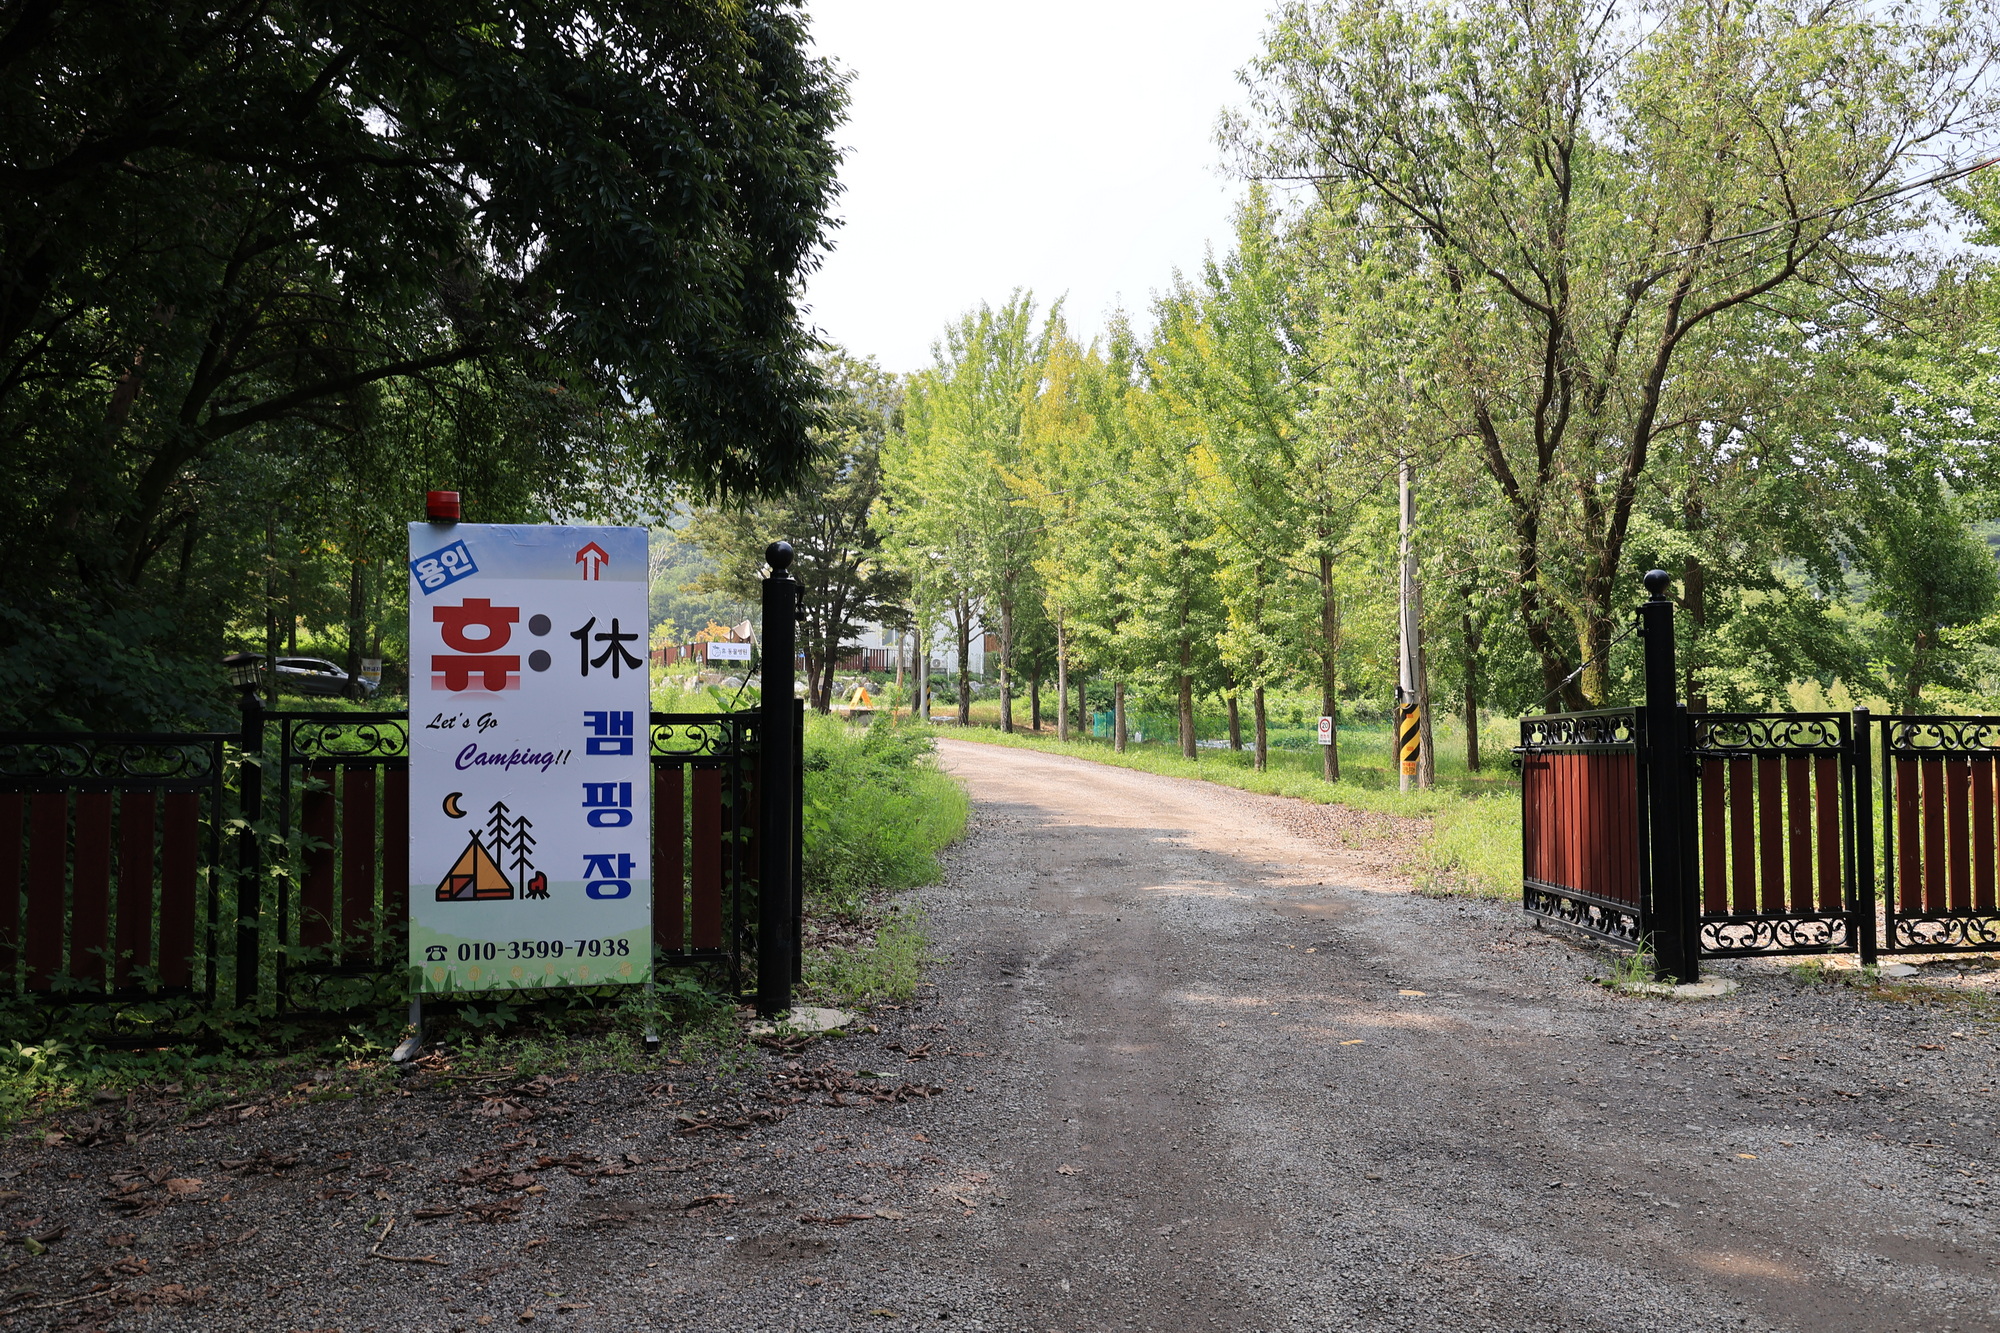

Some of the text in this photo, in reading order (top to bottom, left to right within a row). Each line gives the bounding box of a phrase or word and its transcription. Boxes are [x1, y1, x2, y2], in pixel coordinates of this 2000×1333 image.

[416, 545, 473, 589] 용인
[570, 616, 643, 679] 休
[425, 712, 499, 733] Let's Go
[455, 743, 572, 773] Camping!!
[581, 710, 637, 900] 캠핑장
[457, 938, 631, 961] 010-3599-7938
